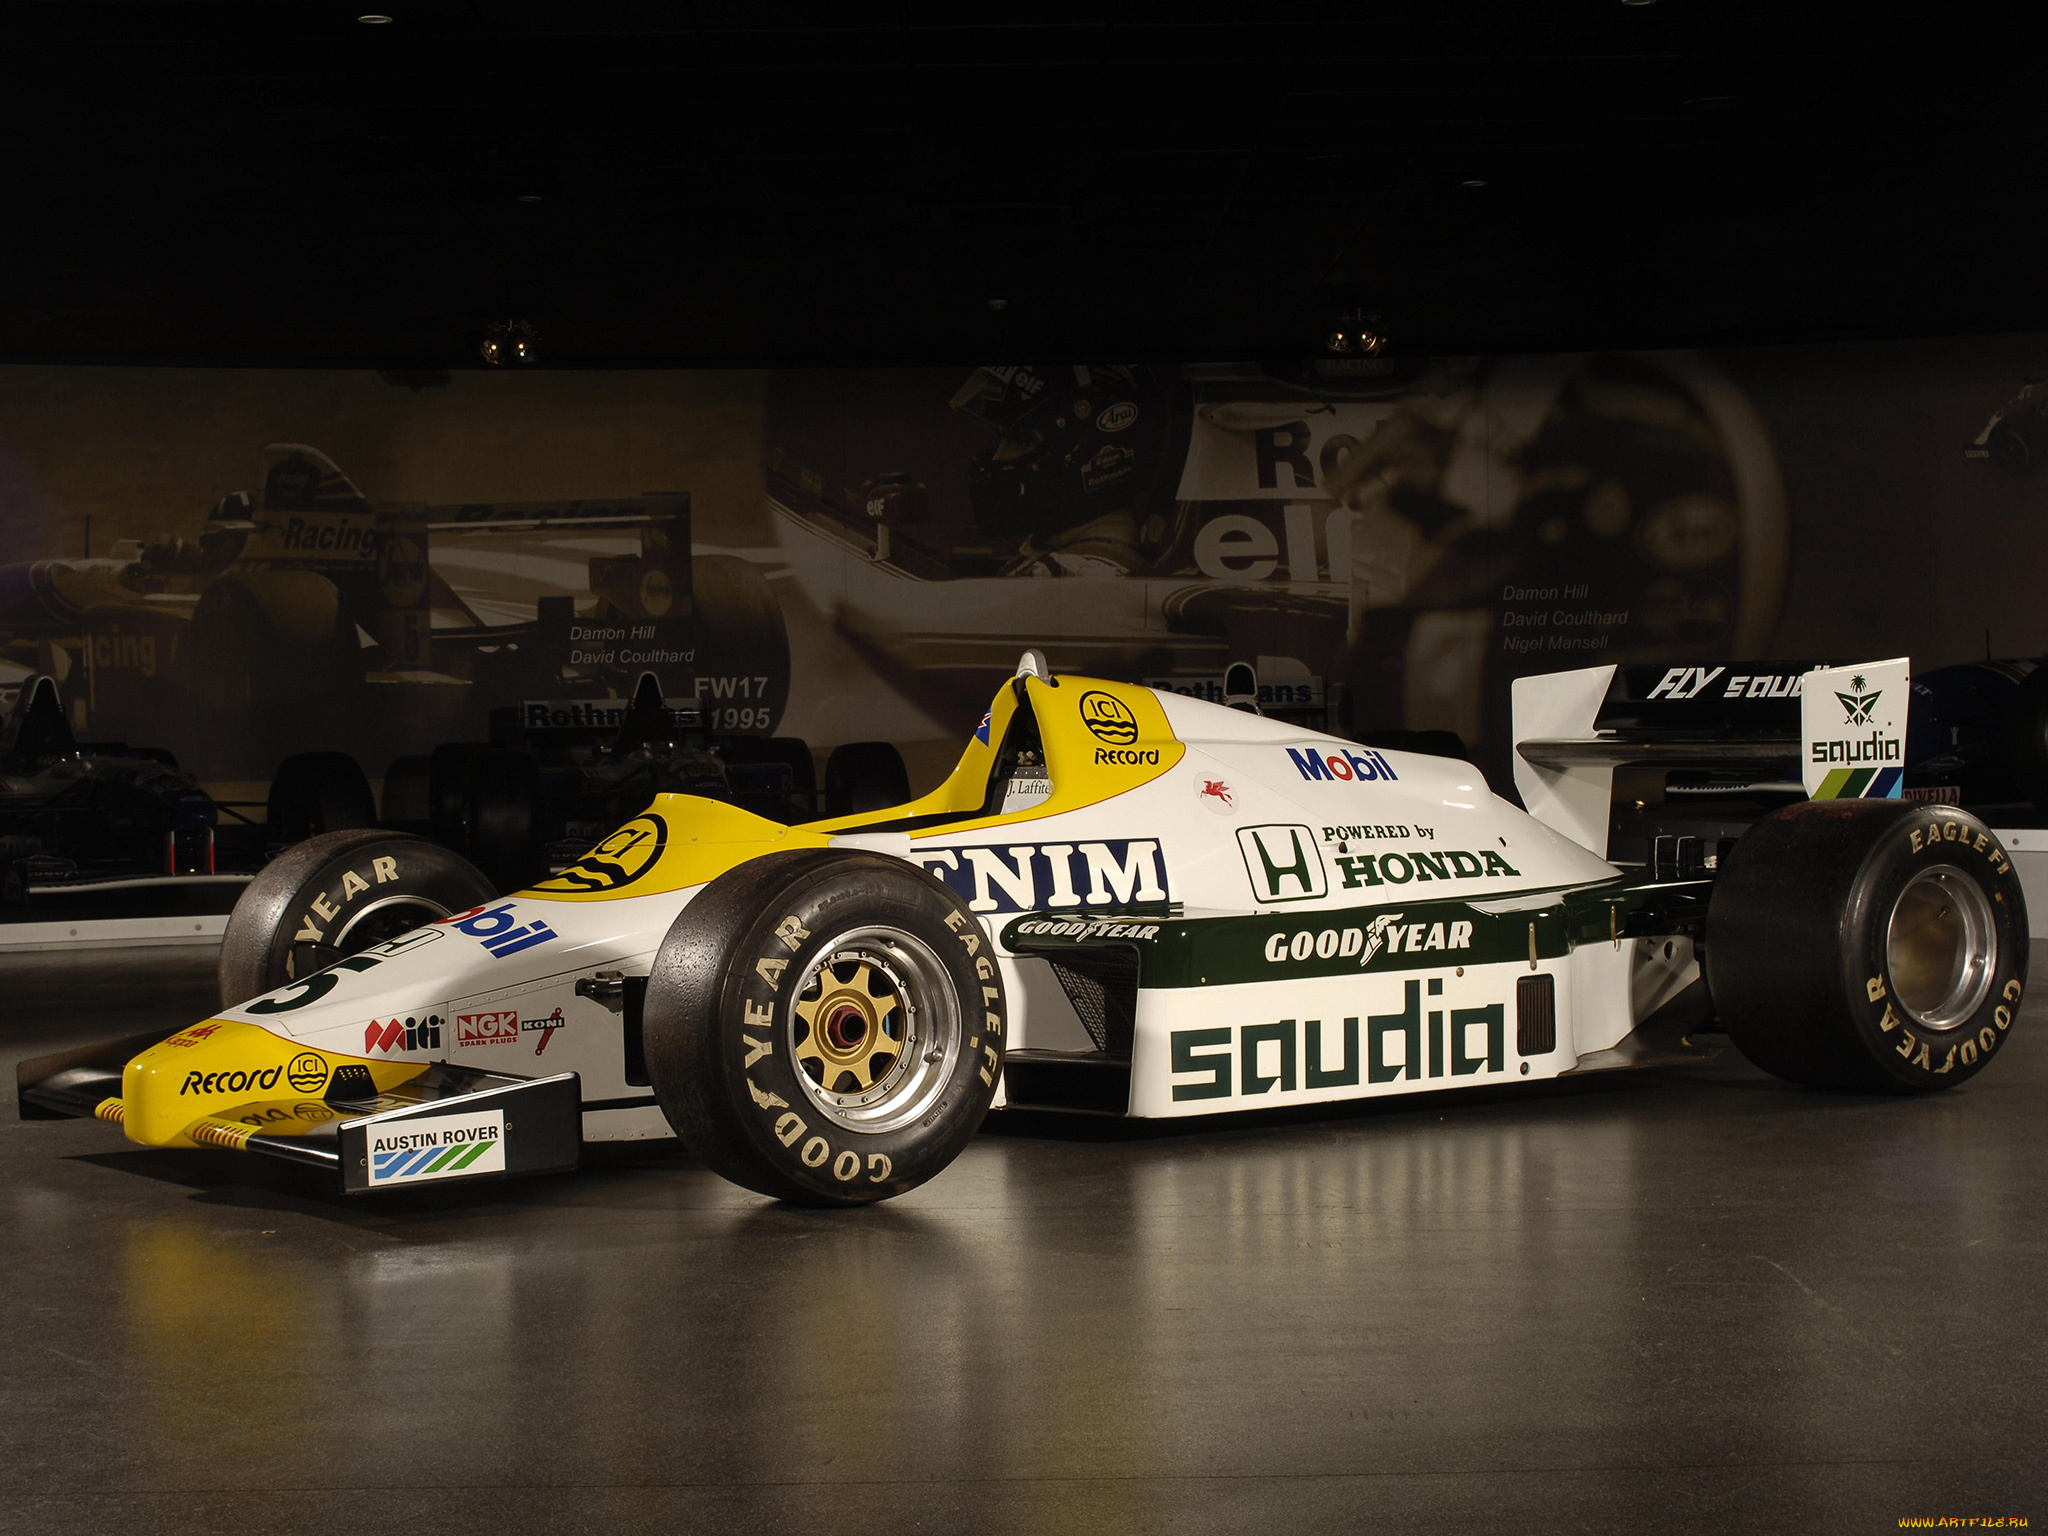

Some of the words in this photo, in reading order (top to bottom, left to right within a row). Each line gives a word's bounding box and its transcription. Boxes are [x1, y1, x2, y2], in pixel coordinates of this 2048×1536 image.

[1015, 372, 1044, 394] elf
[1103, 409, 1133, 425] Arai
[866, 498, 884, 516] elf
[284, 517, 376, 558] Racing
[1503, 585, 1558, 601] Damon
[1564, 584, 1589, 599] Hill
[1503, 611, 1547, 626] David
[1553, 610, 1629, 626] Coulthard
[570, 627, 625, 640] Damon
[631, 626, 656, 640] Hill
[1503, 636, 1543, 653] Nigel
[1548, 635, 1609, 649] Mansell
[95, 623, 157, 676] cing
[570, 650, 615, 664] David
[619, 649, 695, 663] Coulthard
[694, 677, 769, 699] FW17
[1152, 681, 1312, 703] Rothans
[1646, 666, 1726, 699] FLY
[527, 703, 698, 727] Rothms
[711, 708, 771, 730] 1995
[1089, 700, 1121, 718] ICI
[1094, 748, 1159, 765] Record
[1812, 731, 1901, 763] saudia
[1285, 748, 1399, 781] Mobil
[1007, 780, 1015, 797] J.
[1018, 780, 1049, 794] Laffite
[595, 828, 651, 859] CI
[1322, 824, 1410, 841] POWERED
[1414, 824, 1434, 840] by
[1911, 821, 1989, 854] EAGLE
[1334, 850, 1521, 889] HONDA
[944, 908, 1002, 1037] EAGLE
[458, 1012, 517, 1040] NGK
[523, 1019, 564, 1030] KONI
[490, 1037, 518, 1045] PLUGS
[1171, 978, 1504, 1101] saudia
[297, 1059, 319, 1073] ICI
[180, 1065, 283, 1095] Record
[374, 1132, 437, 1152] AUSTIN
[444, 1126, 499, 1144] ROVER
